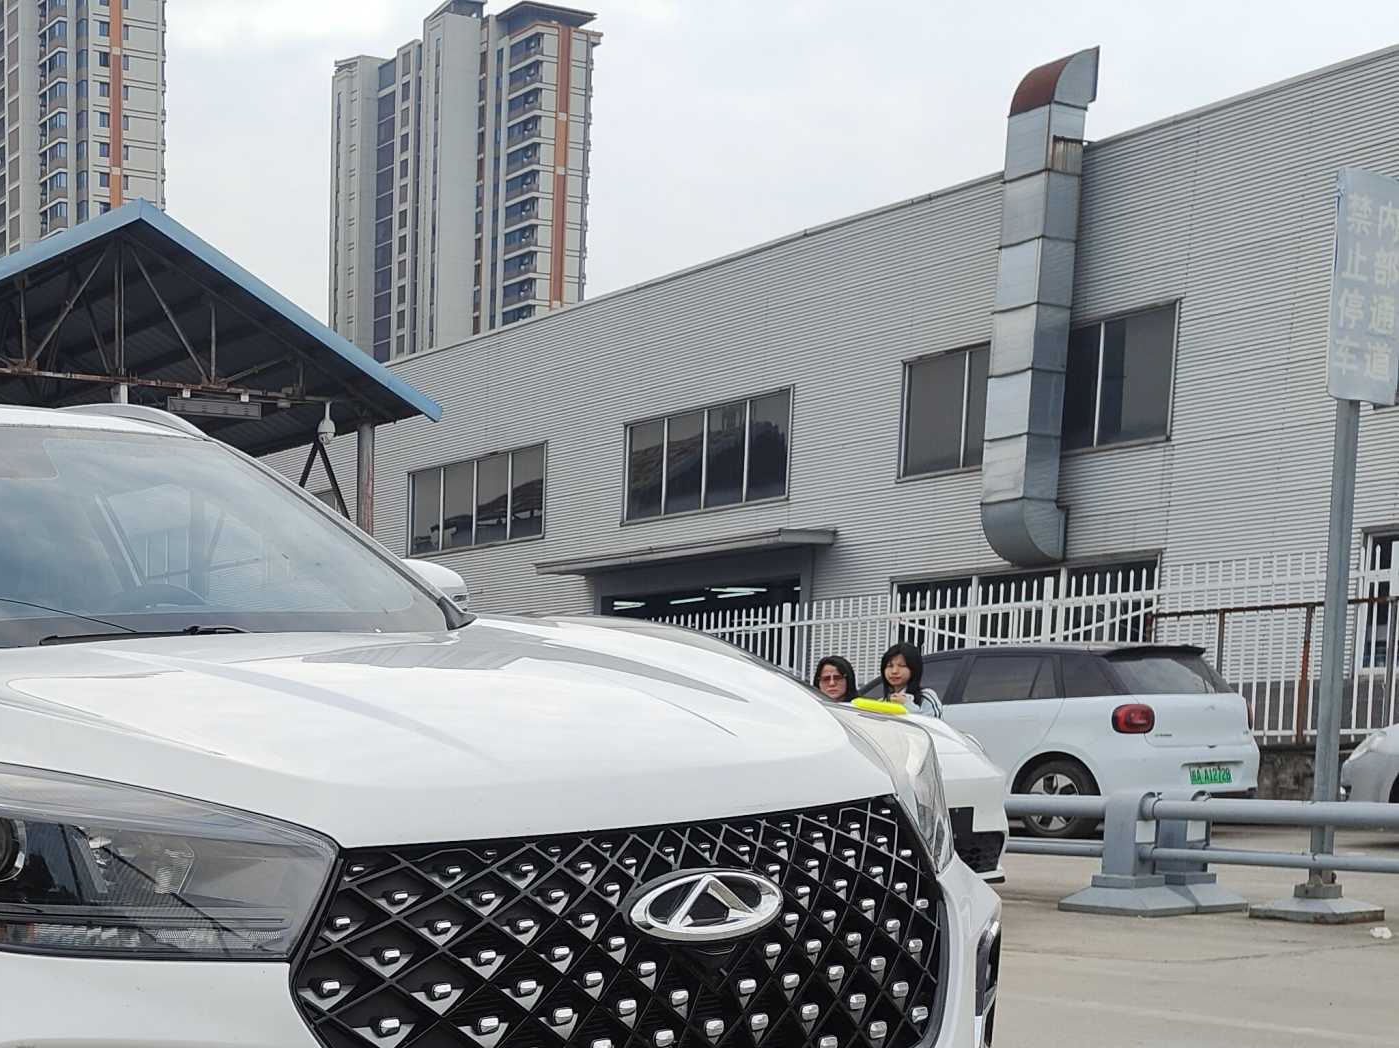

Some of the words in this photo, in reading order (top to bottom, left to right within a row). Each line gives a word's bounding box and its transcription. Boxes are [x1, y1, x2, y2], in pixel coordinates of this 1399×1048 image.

[1335, 193, 1371, 376] 禁止停车
[1364, 202, 1399, 382] 内部通道
